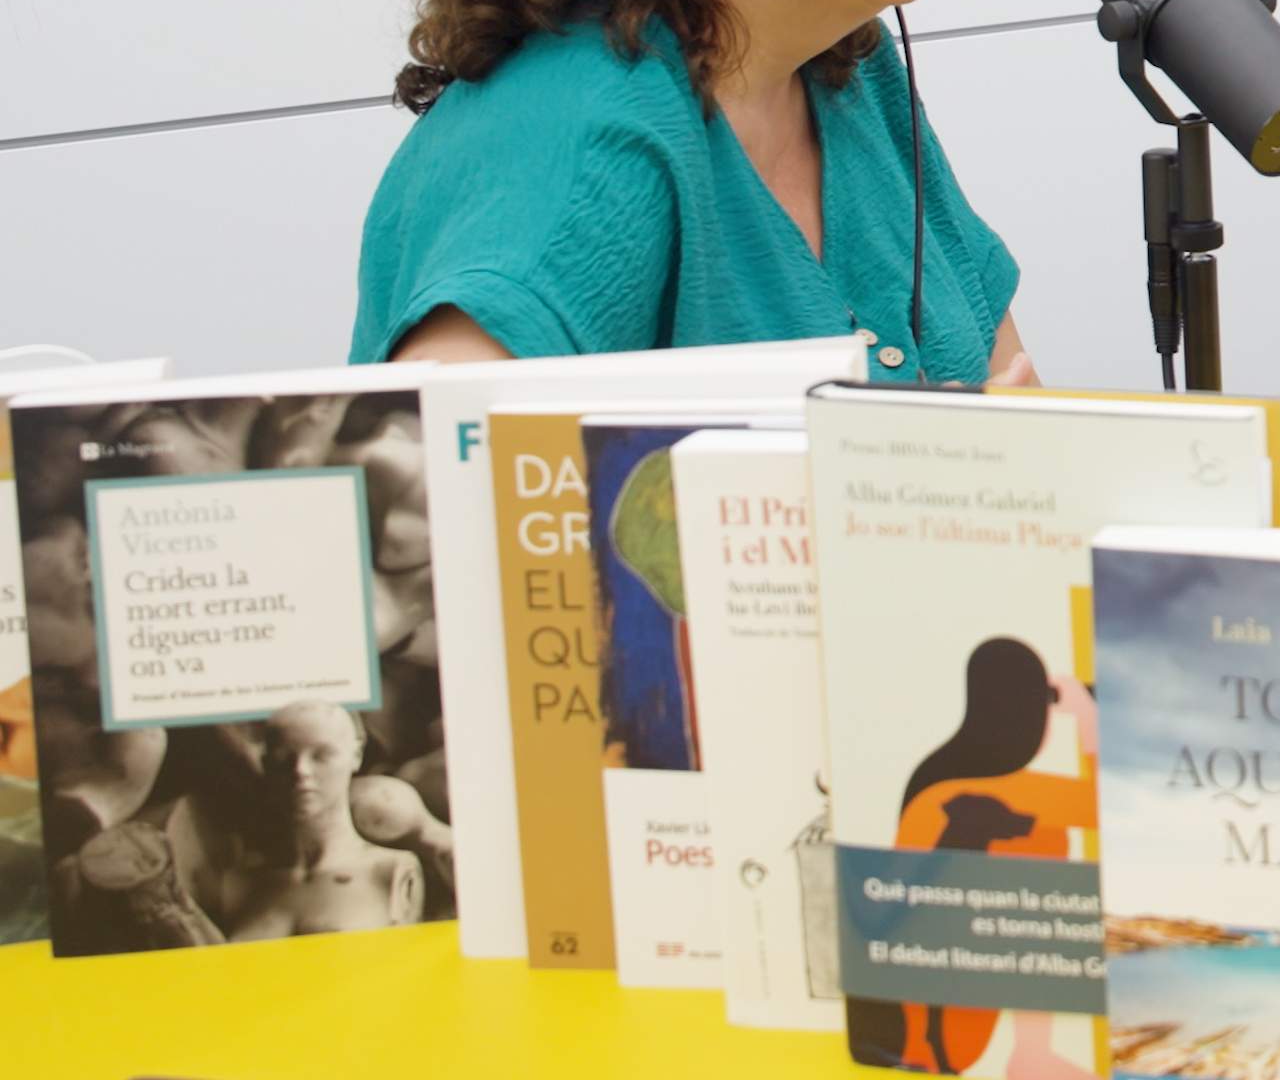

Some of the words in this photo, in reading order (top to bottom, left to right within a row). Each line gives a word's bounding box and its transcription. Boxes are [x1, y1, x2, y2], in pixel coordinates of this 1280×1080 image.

[513, 453, 589, 499] DA
[718, 495, 751, 527] El
[843, 480, 892, 505] Alba
[895, 482, 971, 508] Gómez
[974, 488, 1057, 512] Gabriel
[119, 498, 237, 529] Antònia
[120, 530, 219, 556] Vicens
[844, 510, 870, 537] Jo
[1015, 519, 1084, 552] Plaça
[721, 536, 733, 566] i
[741, 536, 769, 566] el
[123, 565, 218, 594] Crideu
[226, 563, 250, 588] la
[523, 569, 585, 612] EL
[126, 598, 194, 623] mort
[203, 591, 296, 616] errant,
[127, 622, 276, 656] digueu-me
[1212, 615, 1273, 645] Laia
[129, 657, 166, 678] on
[174, 655, 206, 675] va
[532, 683, 597, 723] PA
[863, 877, 906, 903] Què
[907, 883, 964, 908] passa
[966, 888, 1019, 914] quan
[1020, 888, 1040, 911] la
[1041, 890, 1101, 913] ciutat
[970, 917, 997, 936] es
[998, 917, 1053, 938] torna
[549, 935, 580, 957] 62
[867, 940, 889, 963] El
[889, 944, 950, 968] debut
[950, 948, 1018, 971] literari
[1018, 953, 1083, 978] d'Alba
